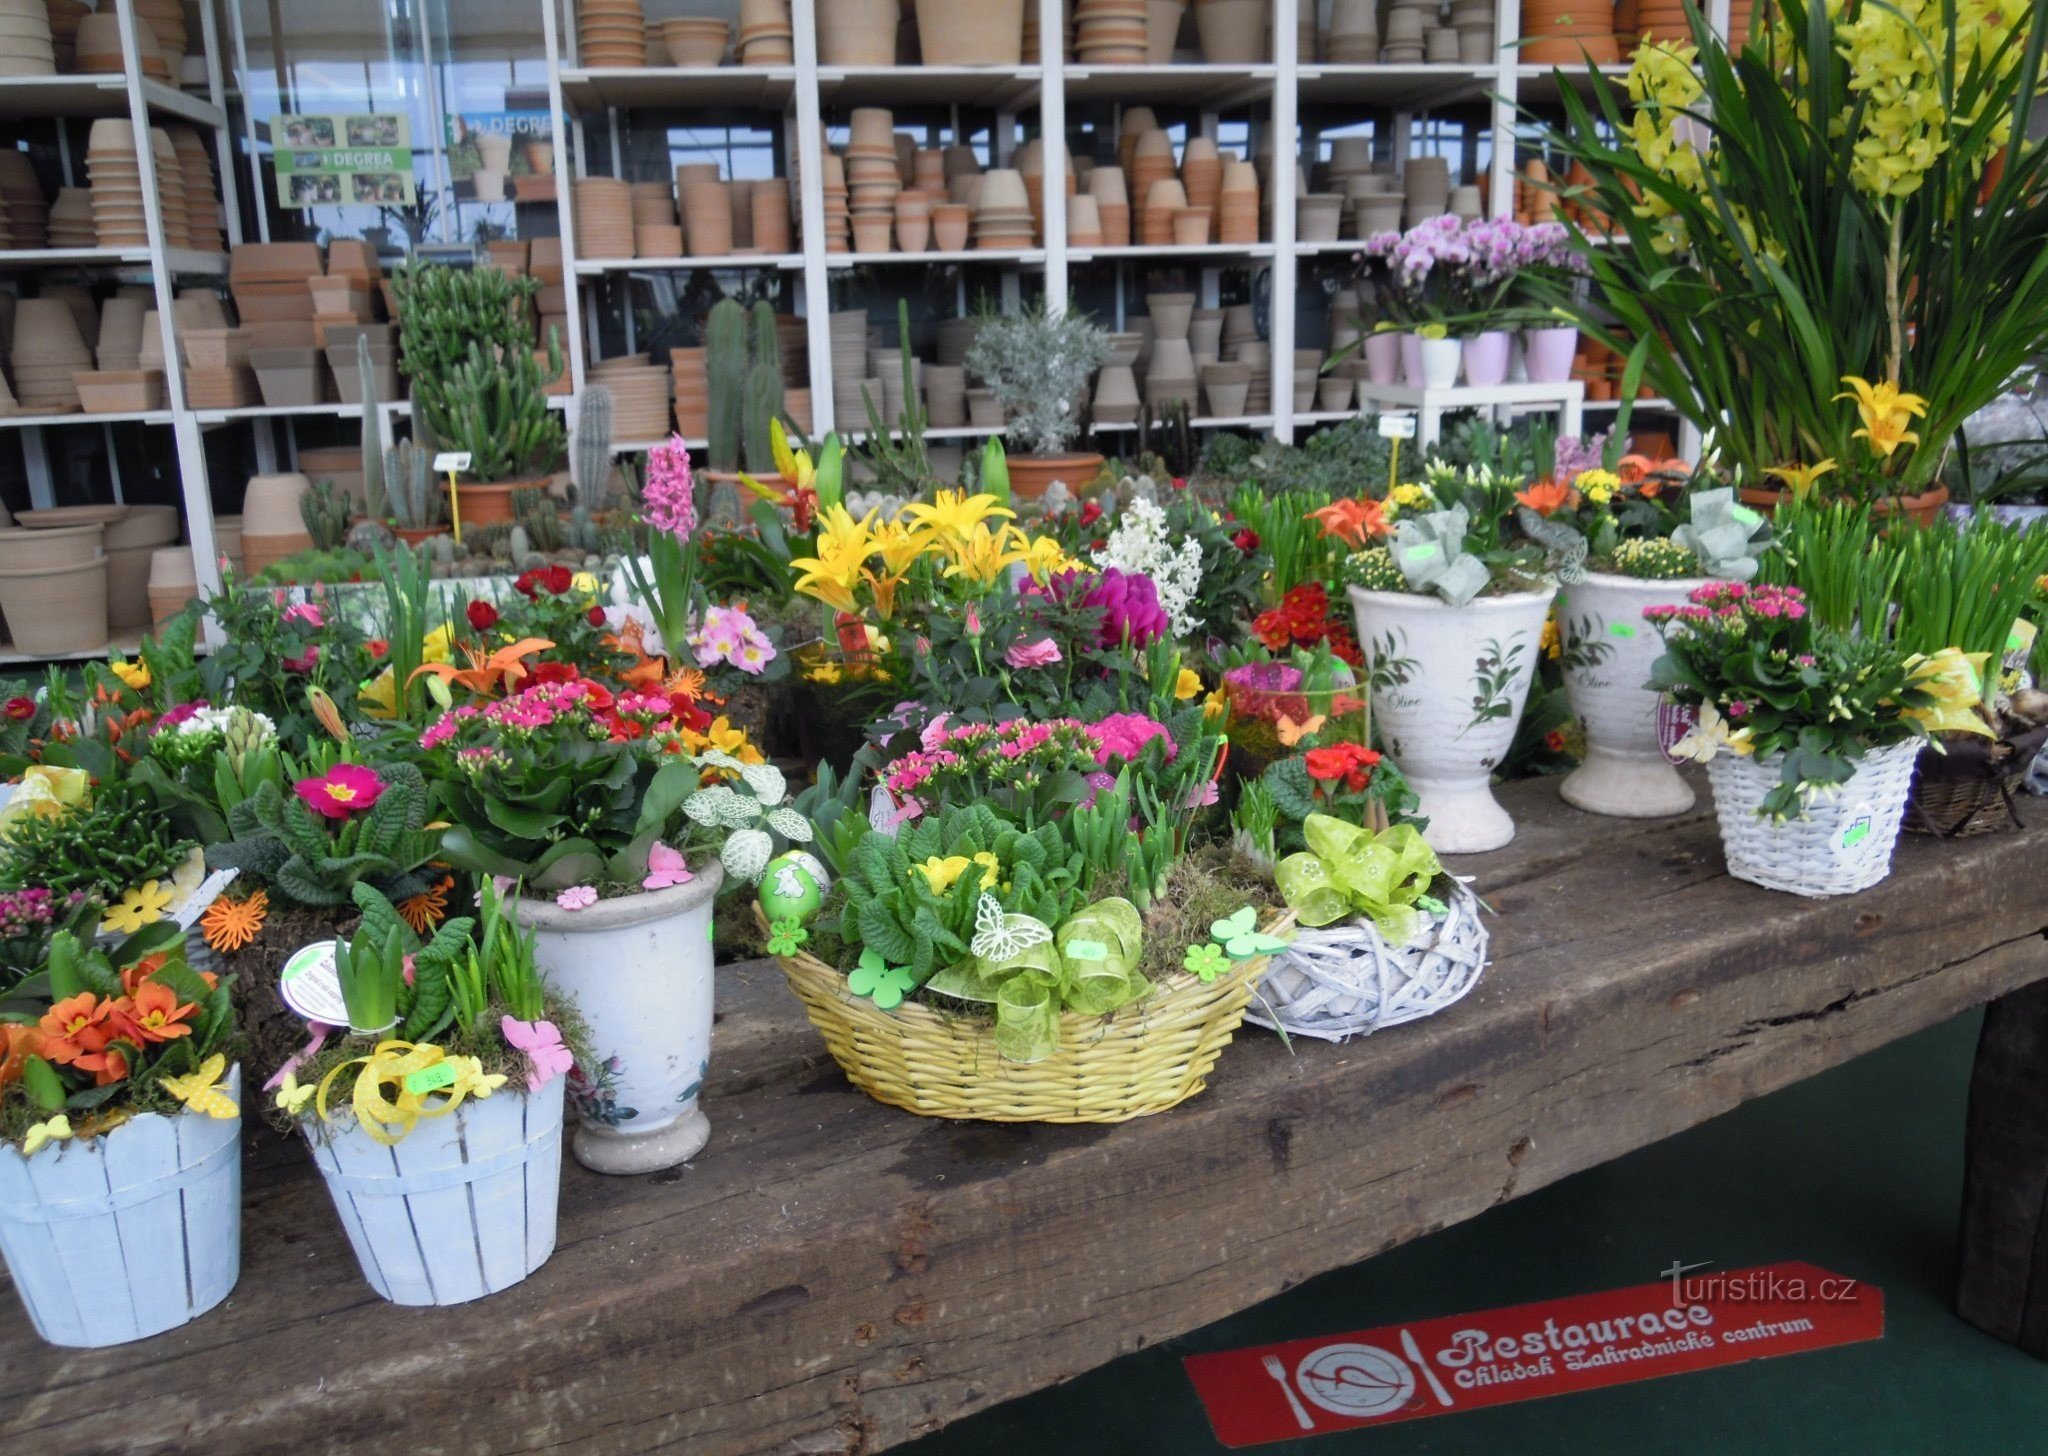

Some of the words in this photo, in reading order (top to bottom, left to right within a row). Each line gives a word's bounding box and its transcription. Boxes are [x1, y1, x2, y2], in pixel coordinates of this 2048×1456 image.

[491, 115, 552, 134] DEGRE
[333, 152, 394, 166] DEGREA
[1435, 1304, 1713, 1368] Restaurace
[1562, 1330, 1715, 1371] Zahradnické
[1721, 1317, 1814, 1344] centrum
